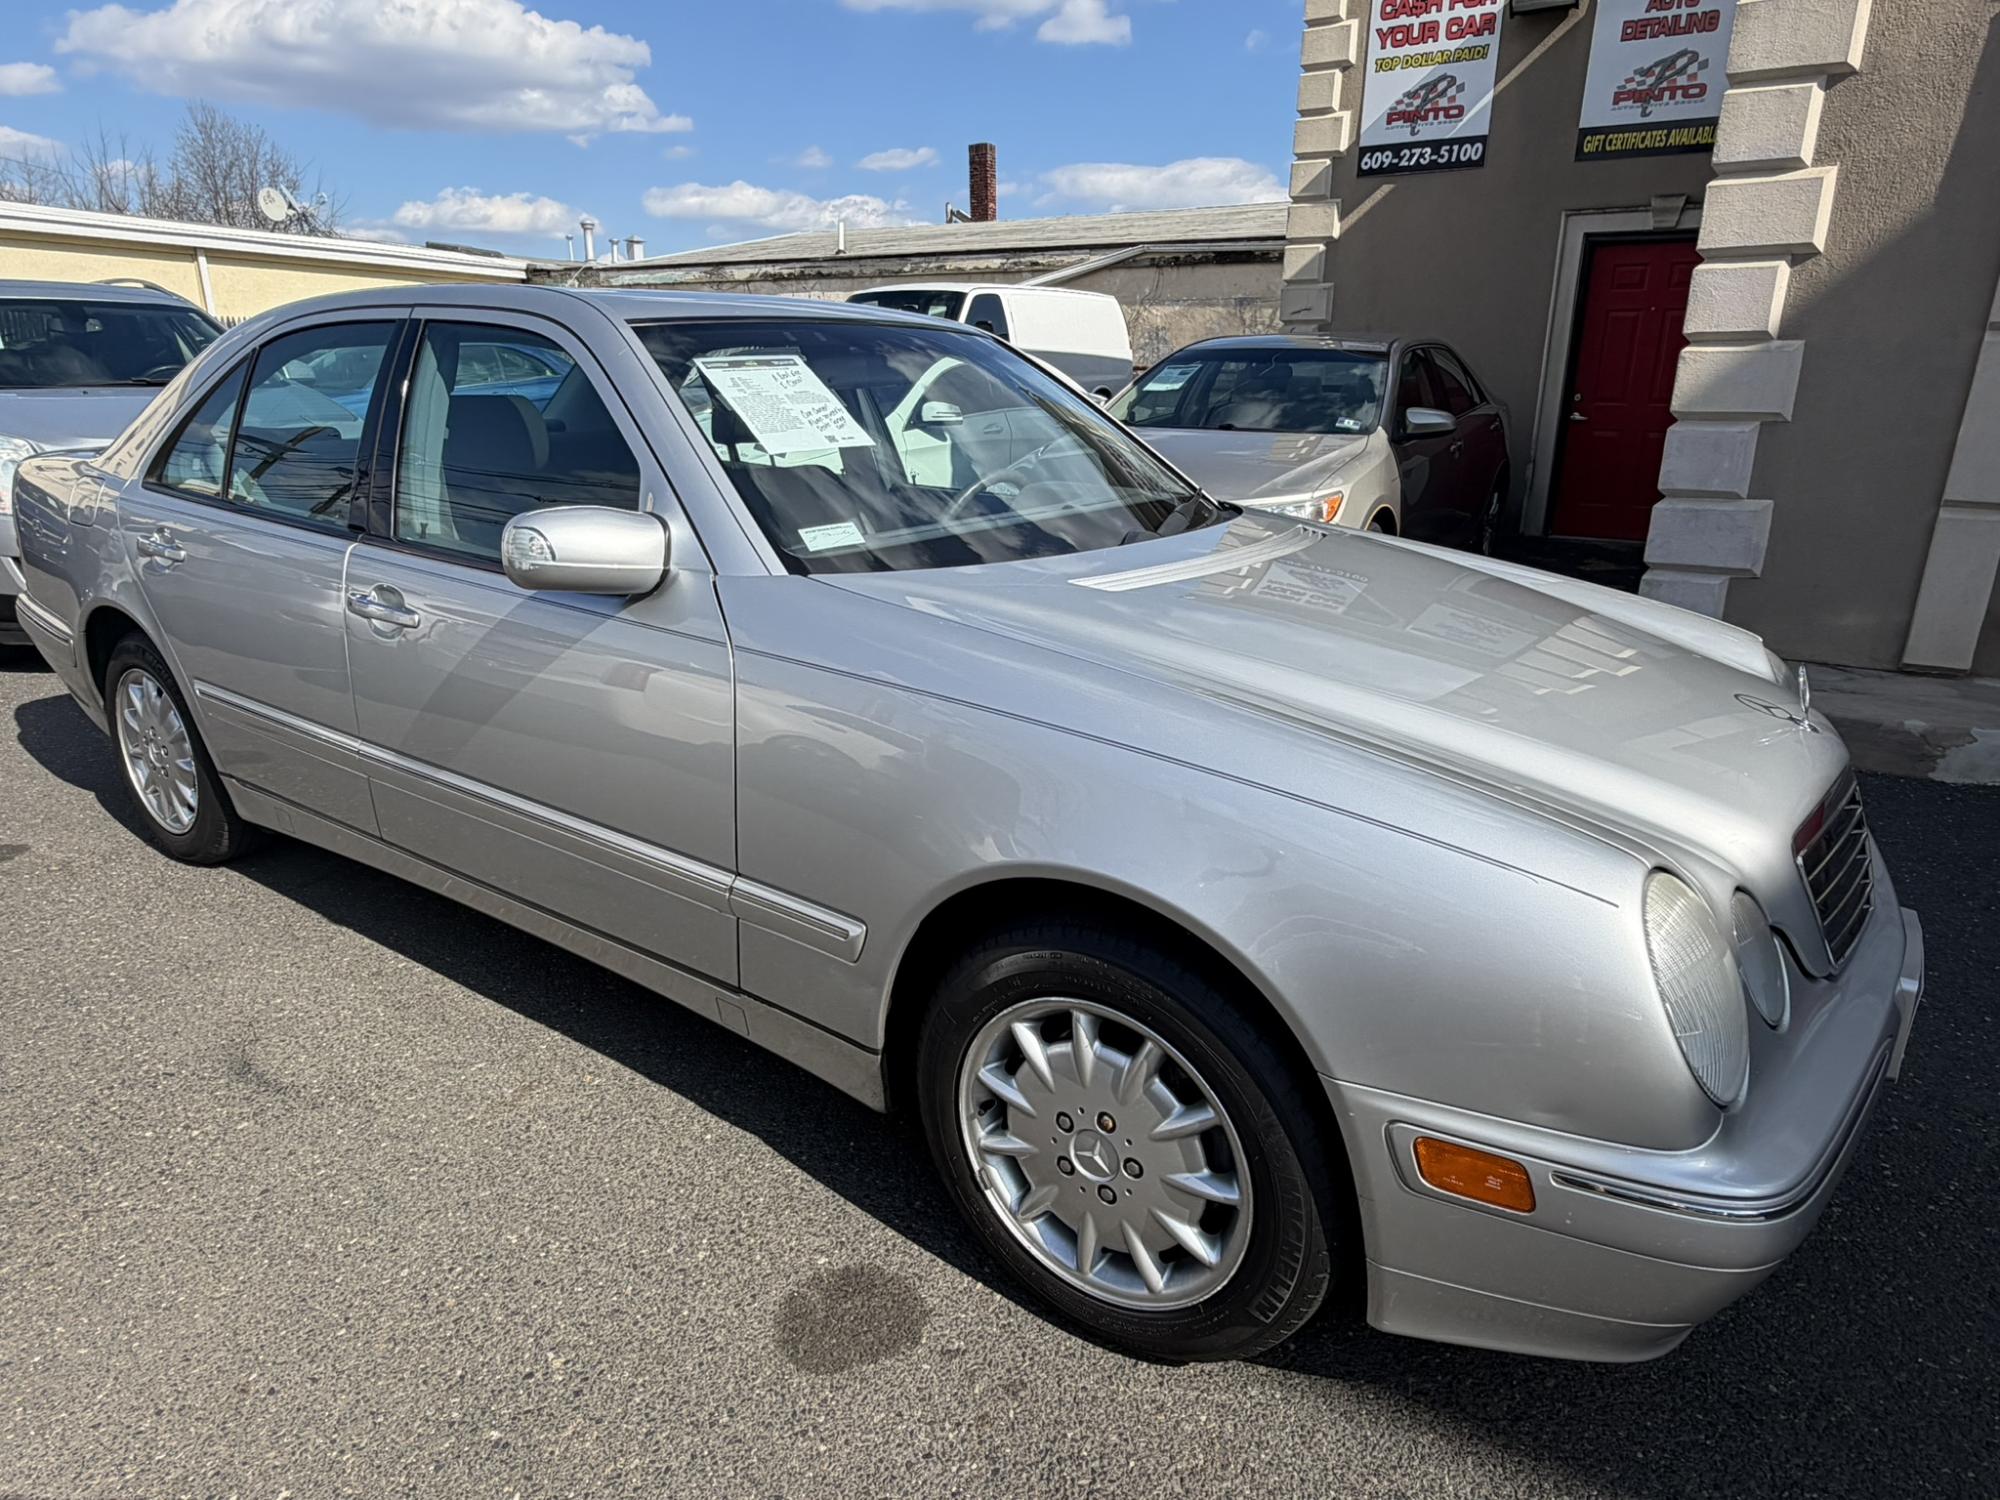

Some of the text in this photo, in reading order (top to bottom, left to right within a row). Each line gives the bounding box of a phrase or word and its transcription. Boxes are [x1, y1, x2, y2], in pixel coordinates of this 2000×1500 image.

[1376, 12, 1497, 49] YOUR CAR
[1620, 9, 1720, 42] DETAILING
[1375, 44, 1490, 73] TOP DOLLAR PAID!
[1612, 82, 1708, 106] PINTO
[1386, 104, 1465, 126] PINTO
[1583, 134, 1605, 153] GIFT
[1605, 129, 1668, 151] CERTIFICATES
[1360, 142, 1483, 170] 609-273-5100
